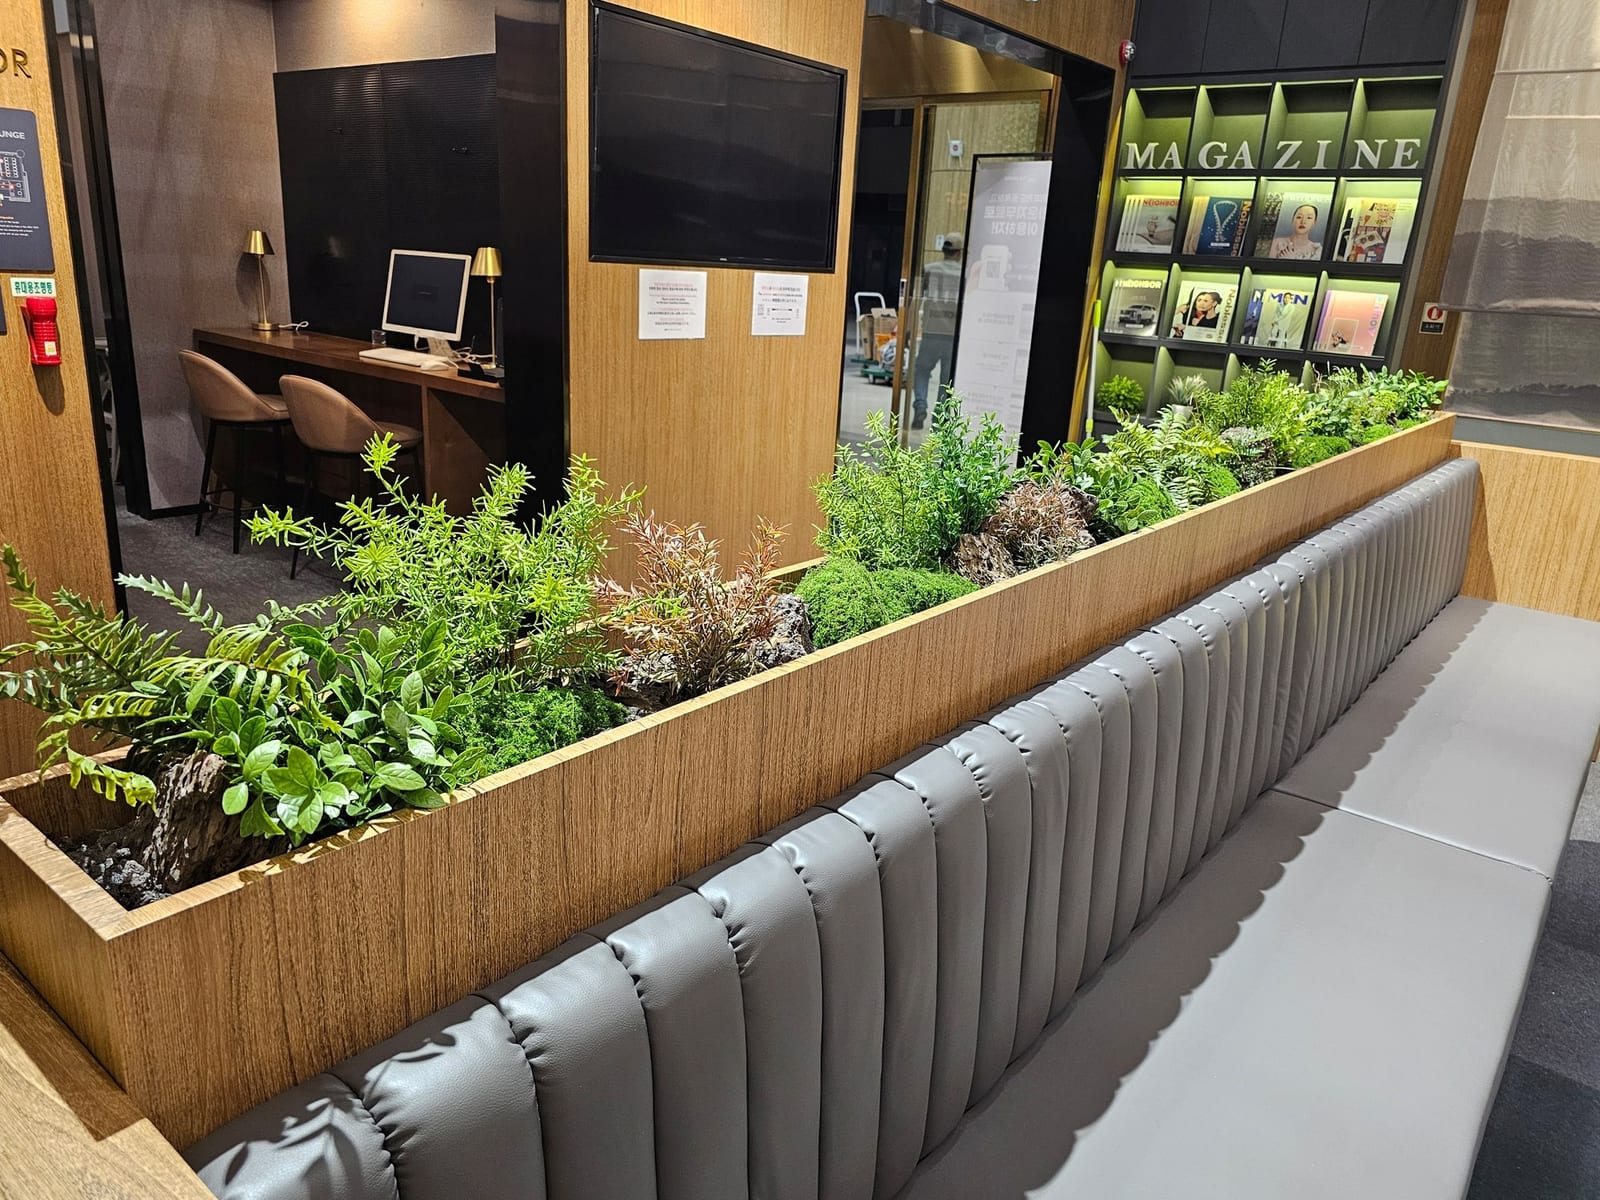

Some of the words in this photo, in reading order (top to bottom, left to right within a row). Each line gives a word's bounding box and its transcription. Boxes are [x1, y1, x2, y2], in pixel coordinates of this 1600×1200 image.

[1123, 138, 1421, 170] MAGAZINE
[15, 281, 53, 295] 휴대용조명등
[1268, 292, 1309, 306] MN
